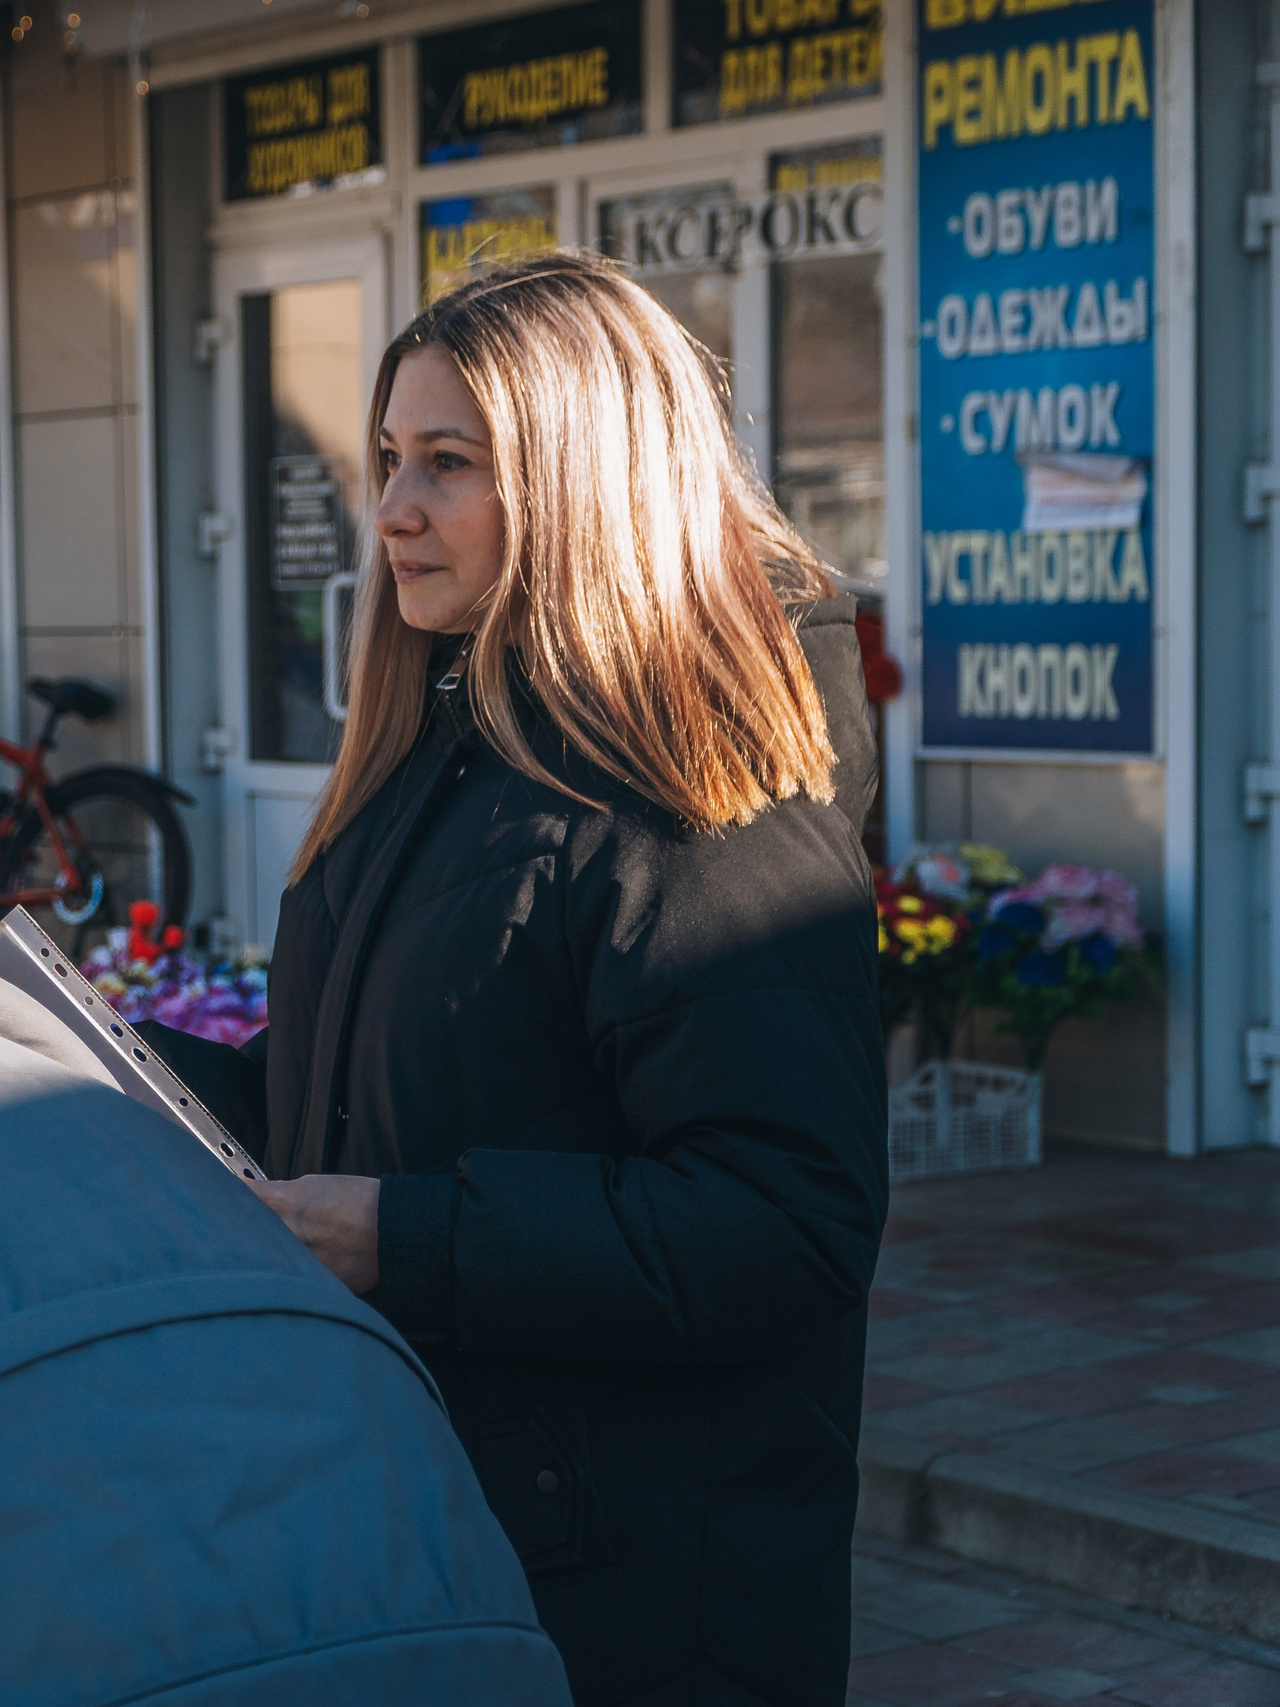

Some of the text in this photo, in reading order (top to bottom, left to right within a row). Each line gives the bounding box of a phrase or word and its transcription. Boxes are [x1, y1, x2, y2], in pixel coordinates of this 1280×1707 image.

[924, 27, 1150, 152] РЕМОНТА
[632, 182, 882, 270] КСЕРОКС
[923, 528, 1150, 606] УСТАНОВКА
[959, 643, 1120, 722] КНОПОК
